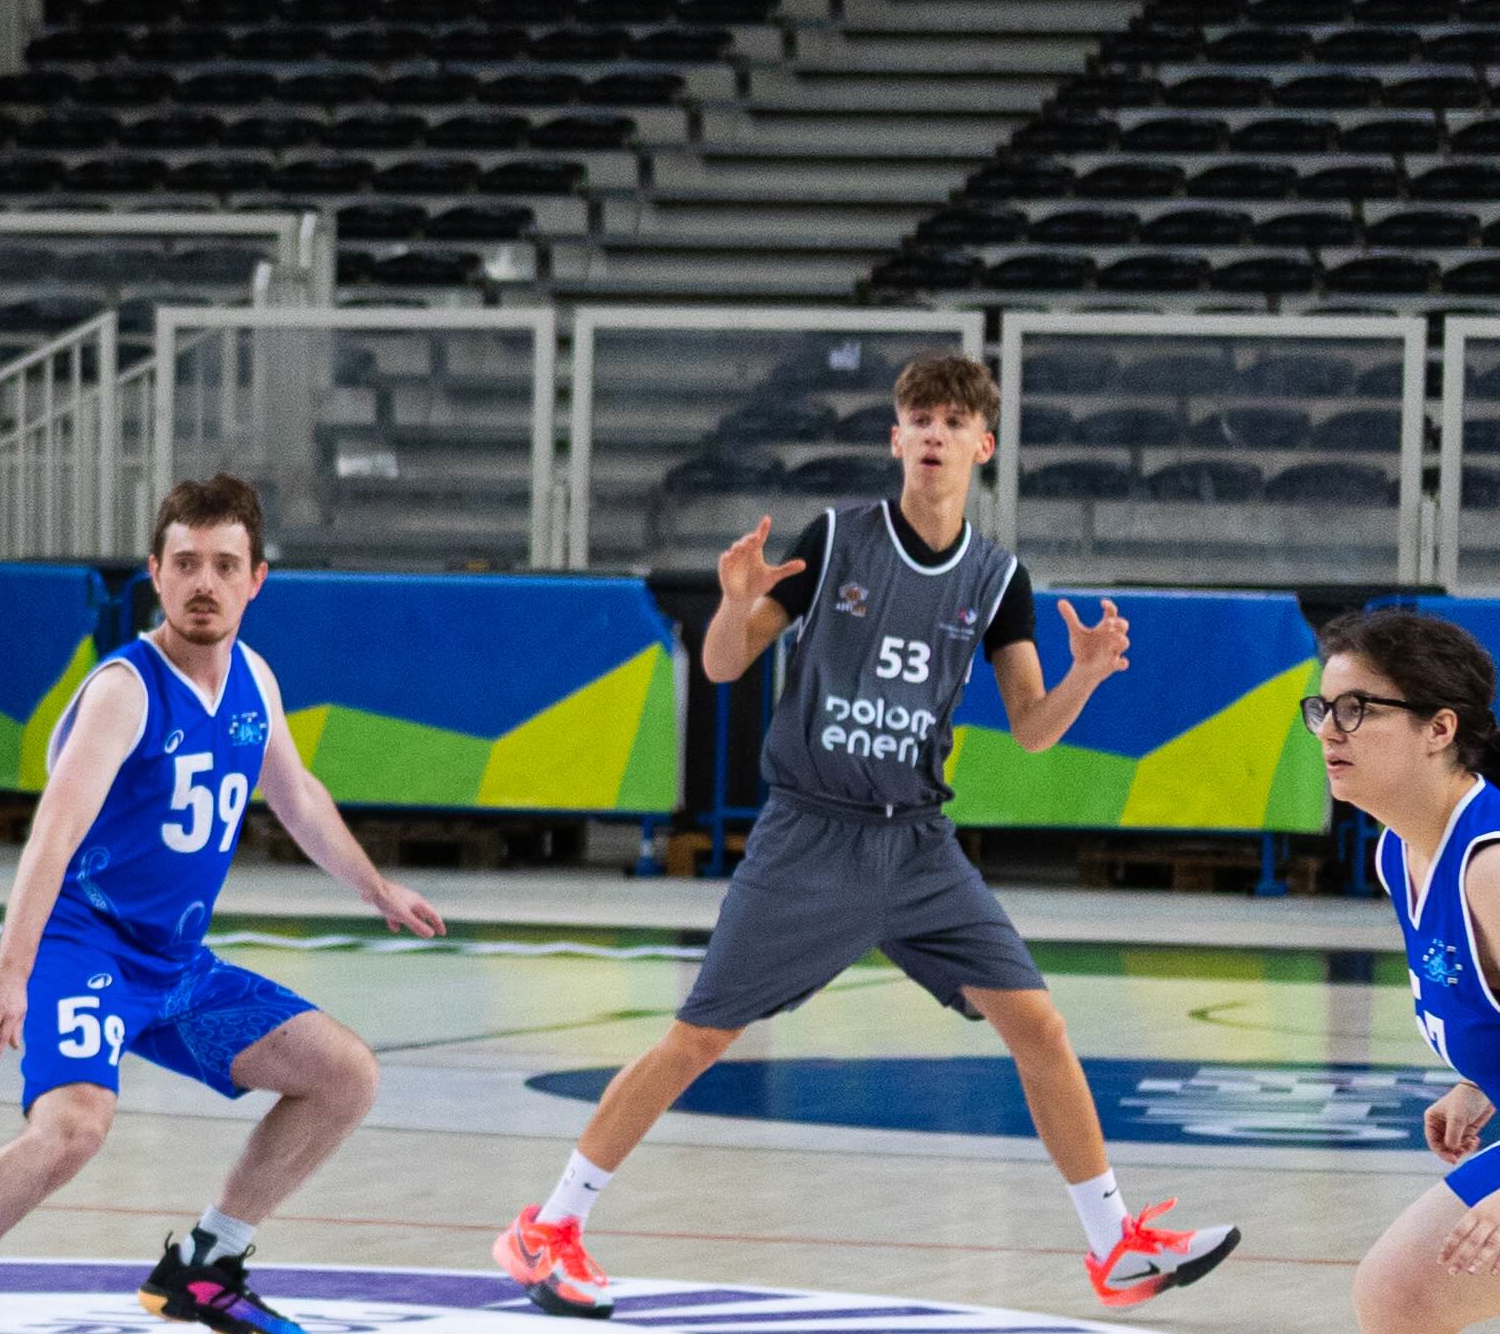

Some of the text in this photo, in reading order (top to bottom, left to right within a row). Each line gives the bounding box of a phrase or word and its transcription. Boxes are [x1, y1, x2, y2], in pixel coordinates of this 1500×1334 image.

[876, 634, 931, 684] 53
[161, 752, 248, 853] 59
[57, 996, 125, 1066] 59
